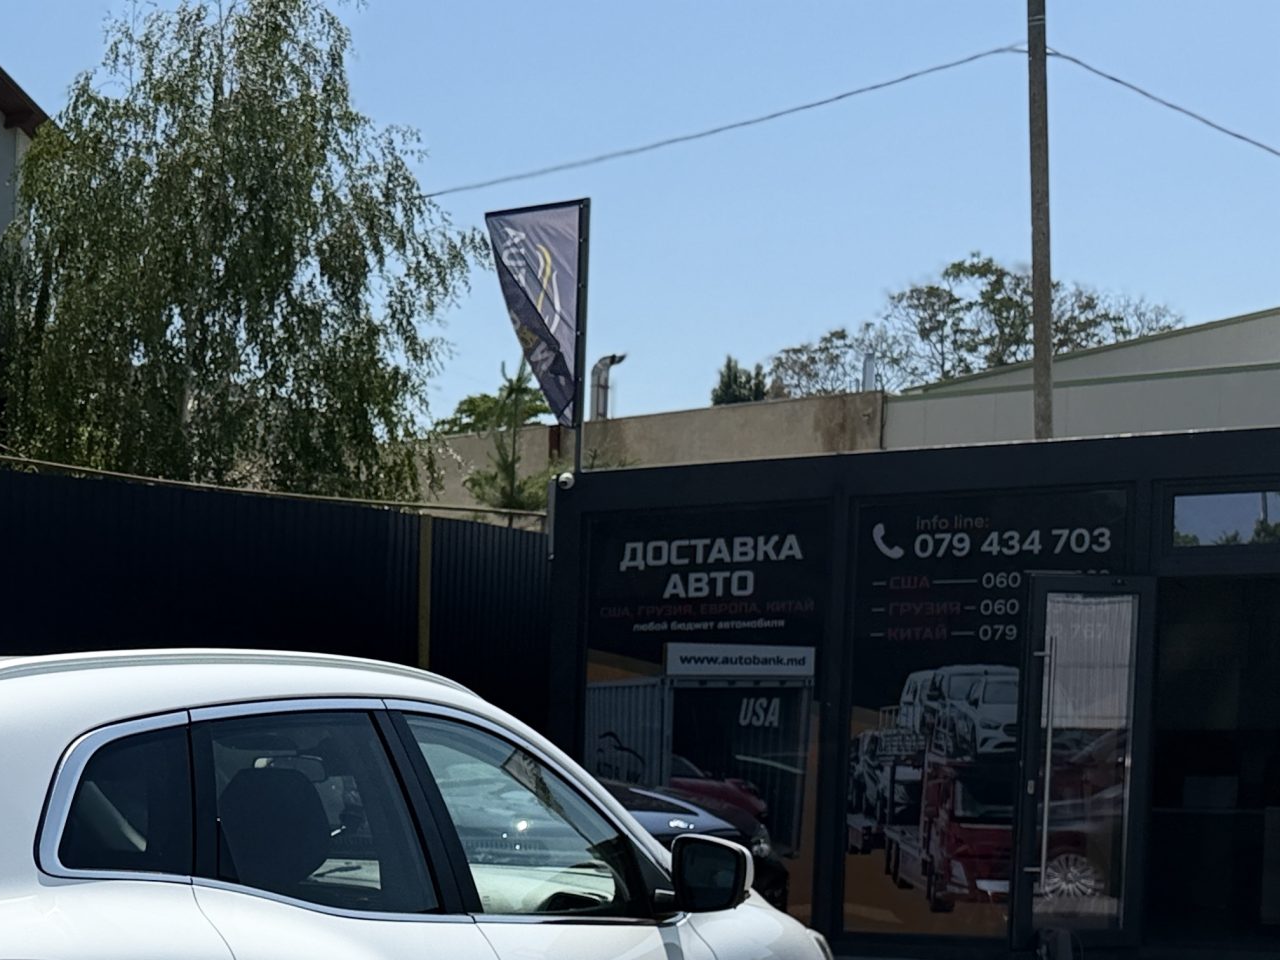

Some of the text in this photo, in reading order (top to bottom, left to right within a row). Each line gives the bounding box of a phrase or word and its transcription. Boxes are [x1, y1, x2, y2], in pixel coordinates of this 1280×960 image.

[915, 513, 990, 531] info line:
[913, 526, 1112, 559] 079 434 703
[618, 533, 805, 573] ДОСТАВКА
[662, 569, 756, 600] АВТО
[888, 571, 1022, 590] США 060
[888, 598, 1020, 617] ГРУЗИЯ 060
[887, 624, 948, 641] КИТАЙ
[978, 623, 1018, 642] 079
[680, 654, 807, 669] www.autobank.md
[738, 696, 781, 728] USA
